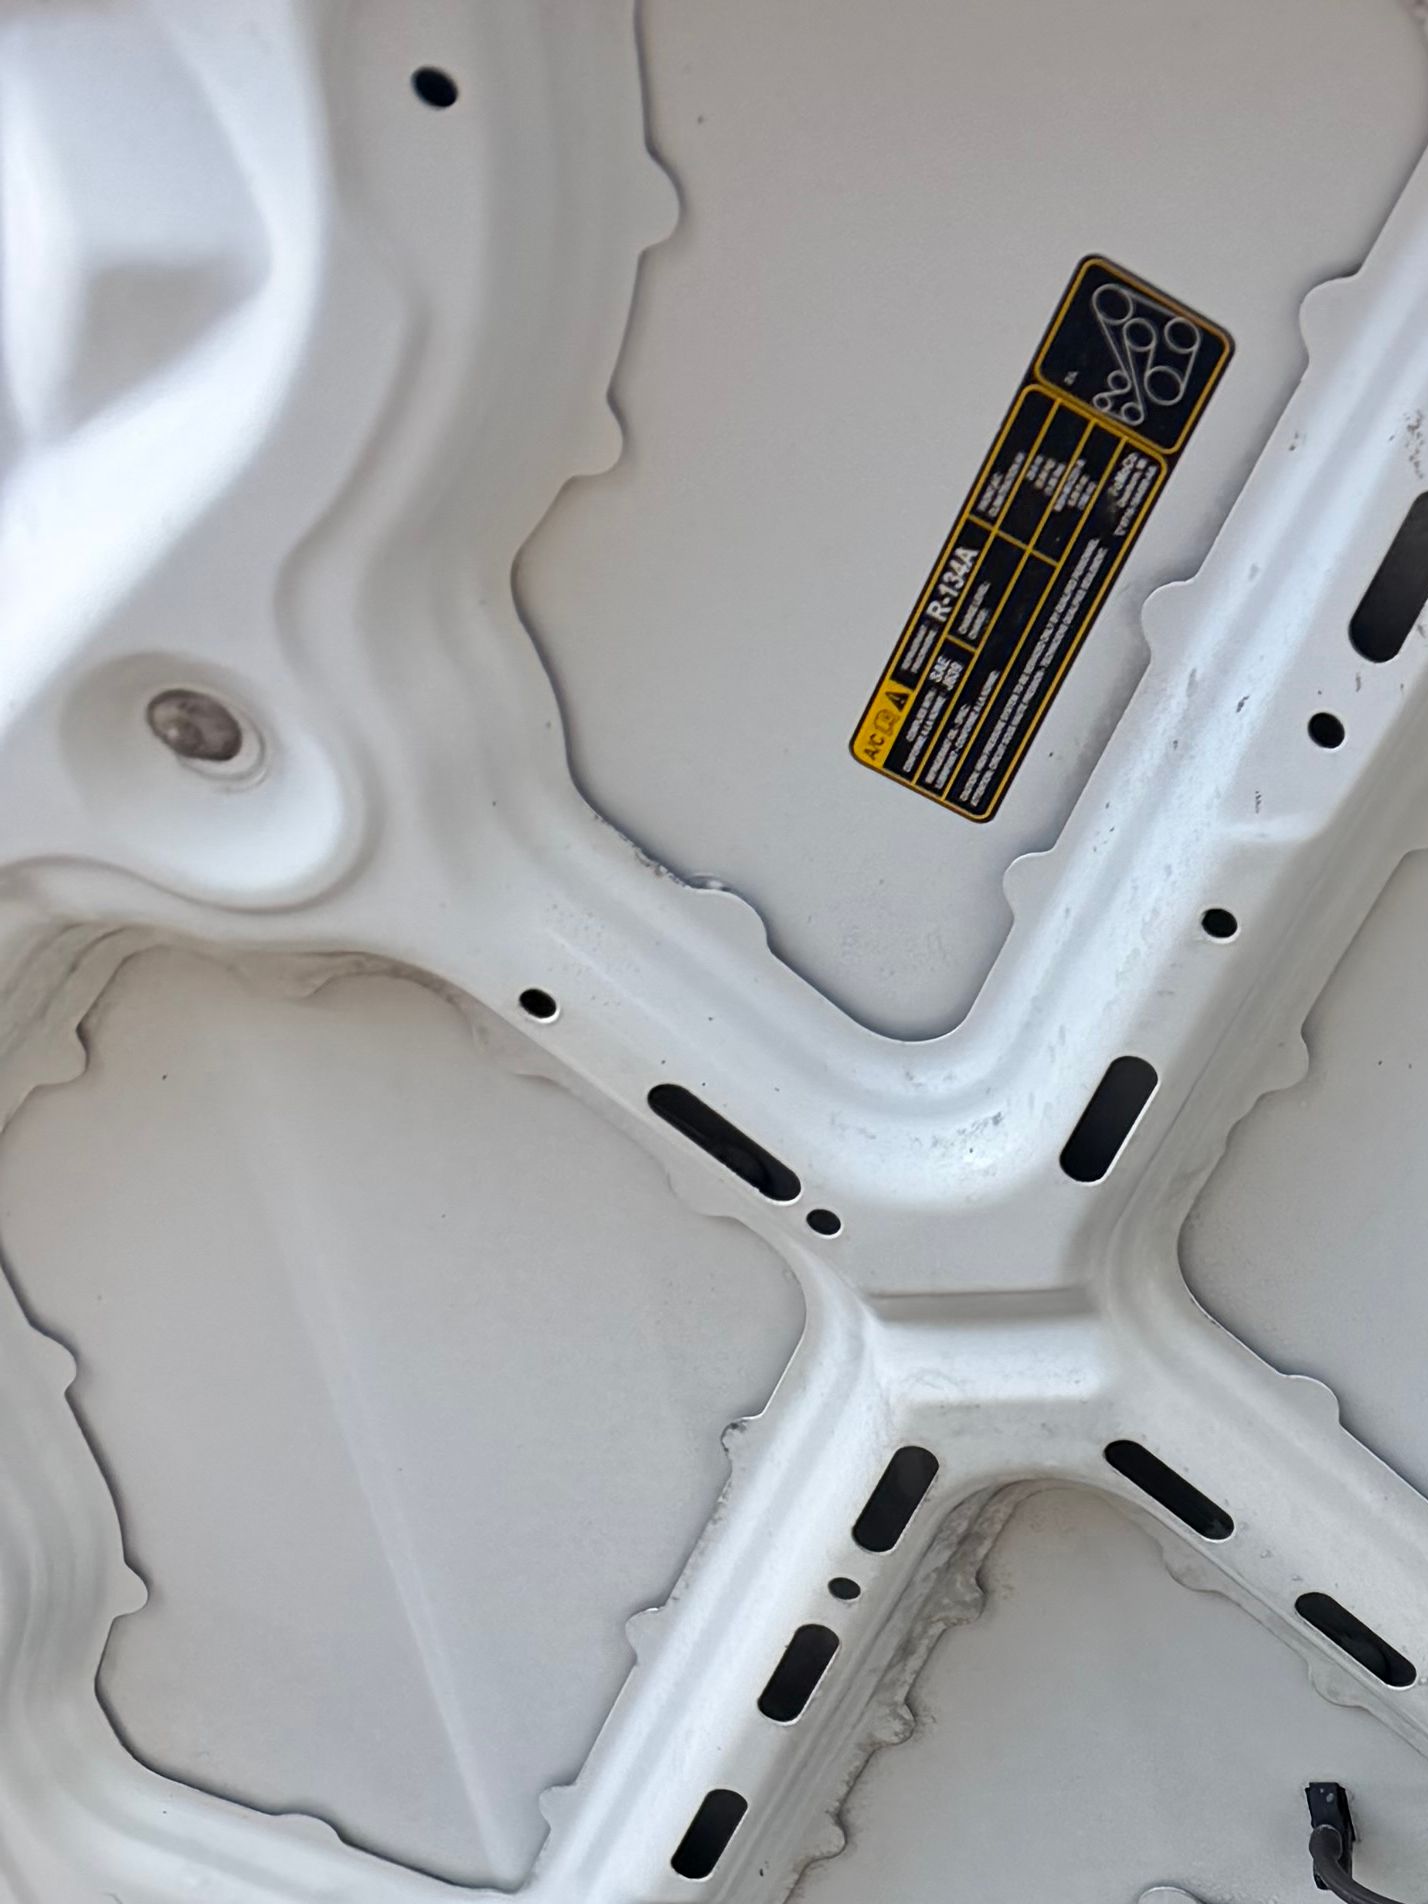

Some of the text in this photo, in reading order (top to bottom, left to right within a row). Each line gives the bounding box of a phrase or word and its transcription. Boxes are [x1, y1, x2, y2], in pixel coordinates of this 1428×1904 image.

[926, 546, 979, 621] R-134A
[928, 654, 951, 684] SAE
[861, 733, 885, 760] A/C
